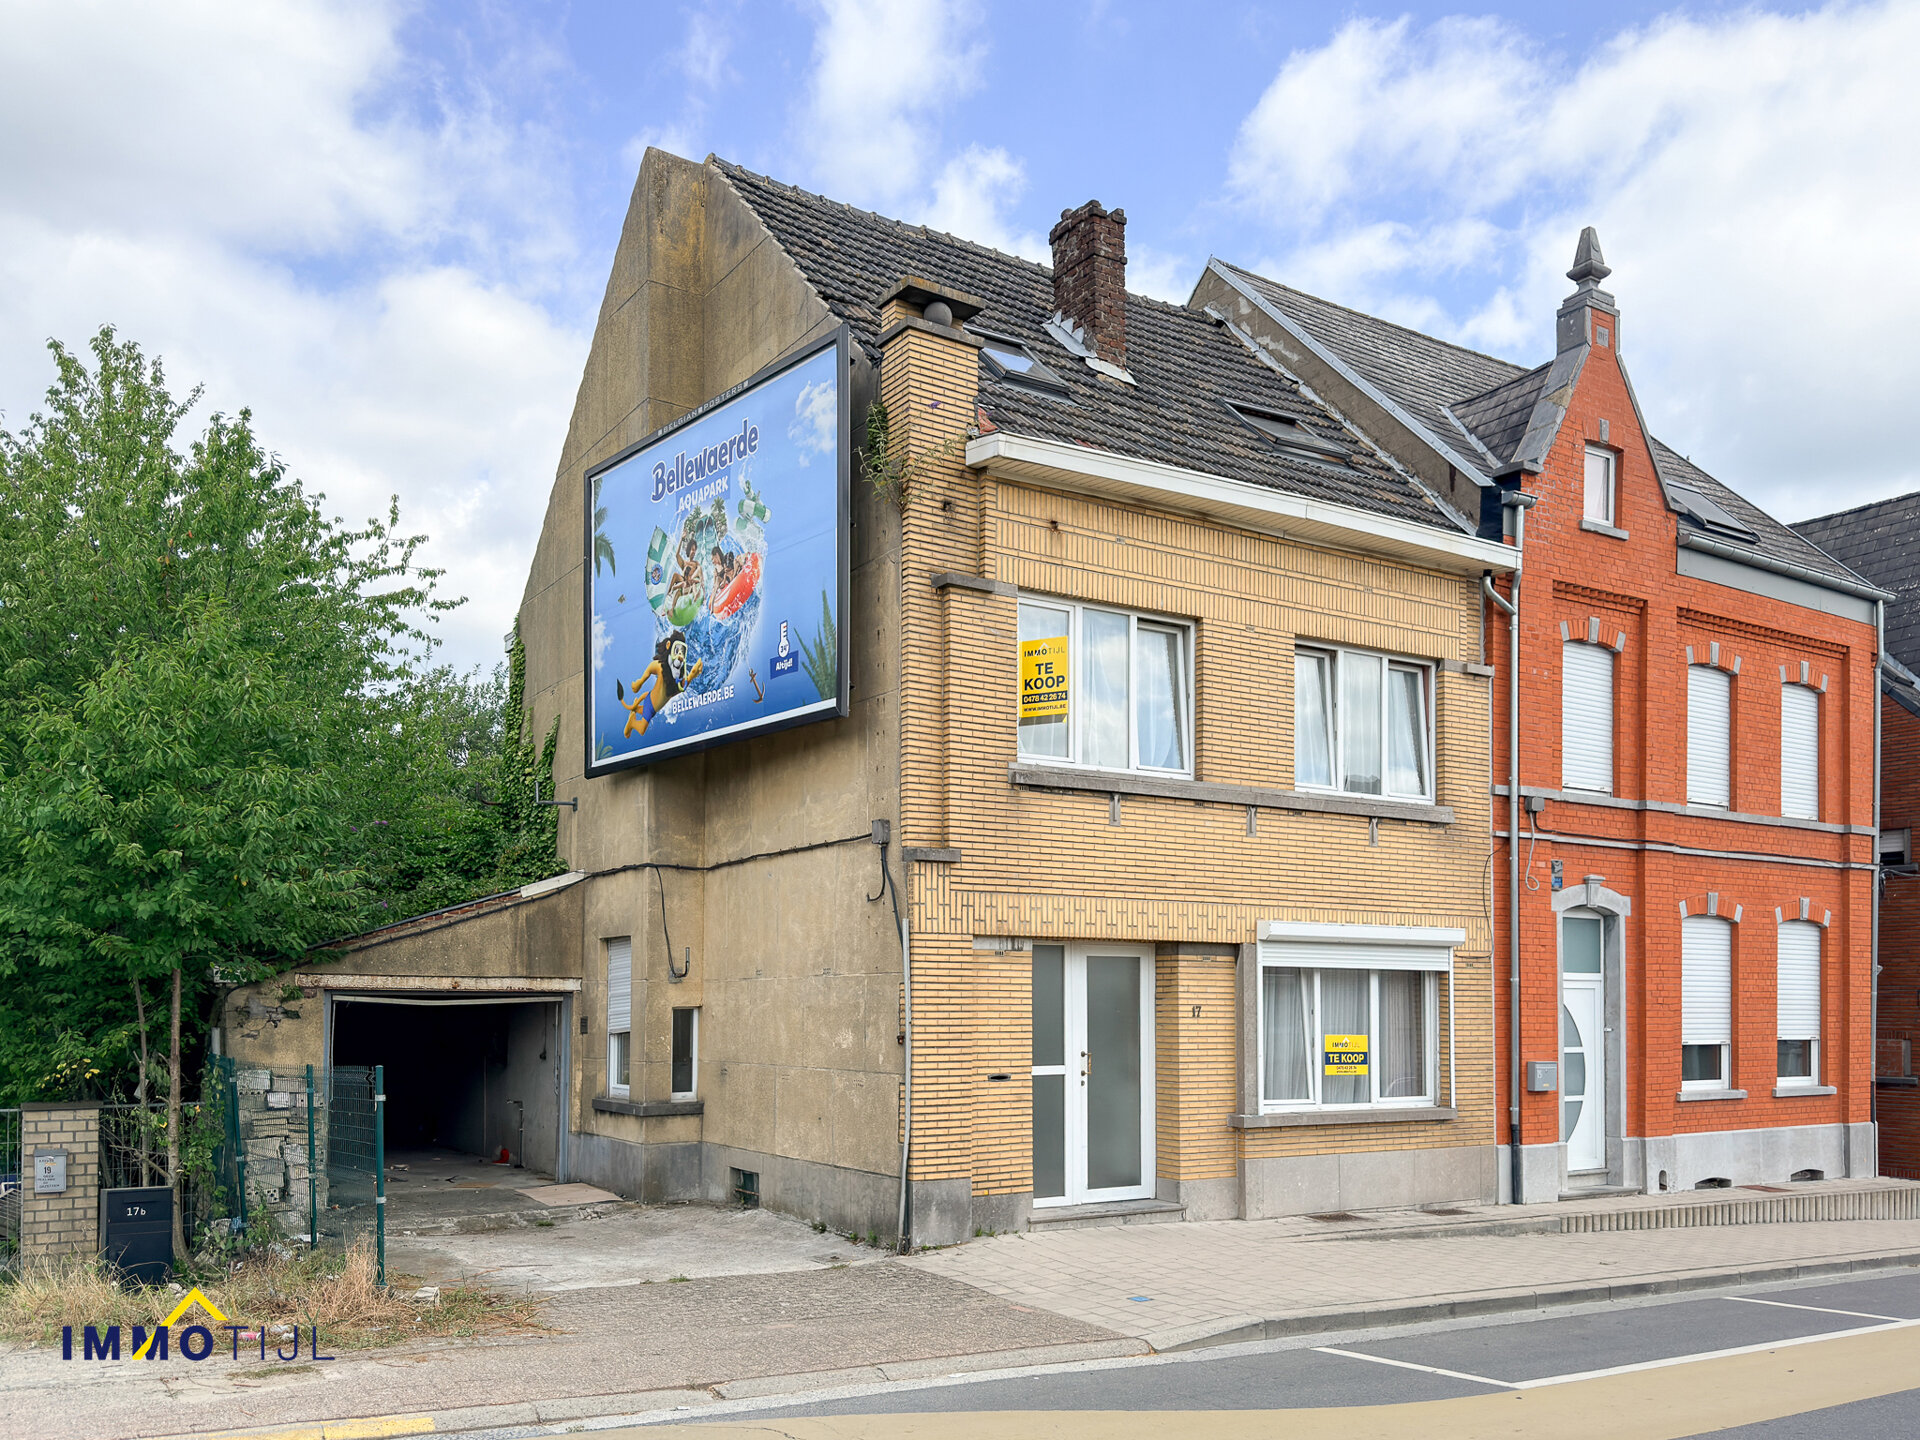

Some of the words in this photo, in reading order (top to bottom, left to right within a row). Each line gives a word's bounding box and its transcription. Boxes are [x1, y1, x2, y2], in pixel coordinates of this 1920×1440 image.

[663, 409, 697, 433] BELGIAN
[703, 384, 743, 411] POSTERS
[651, 417, 759, 503] Bellewaerde
[678, 475, 729, 513] AQUAPARK
[1035, 662, 1054, 675] TE
[1024, 675, 1065, 691] KOOP
[672, 684, 735, 715] BELLEWAERDE.BE
[1040, 694, 1048, 702] 42
[1058, 692, 1066, 700] 74
[1192, 1005, 1202, 1017] 17
[1328, 1053, 1340, 1063] TE
[1341, 1053, 1365, 1063] KOOP
[43, 1166, 52, 1174] 19
[126, 1206, 147, 1216] 17b
